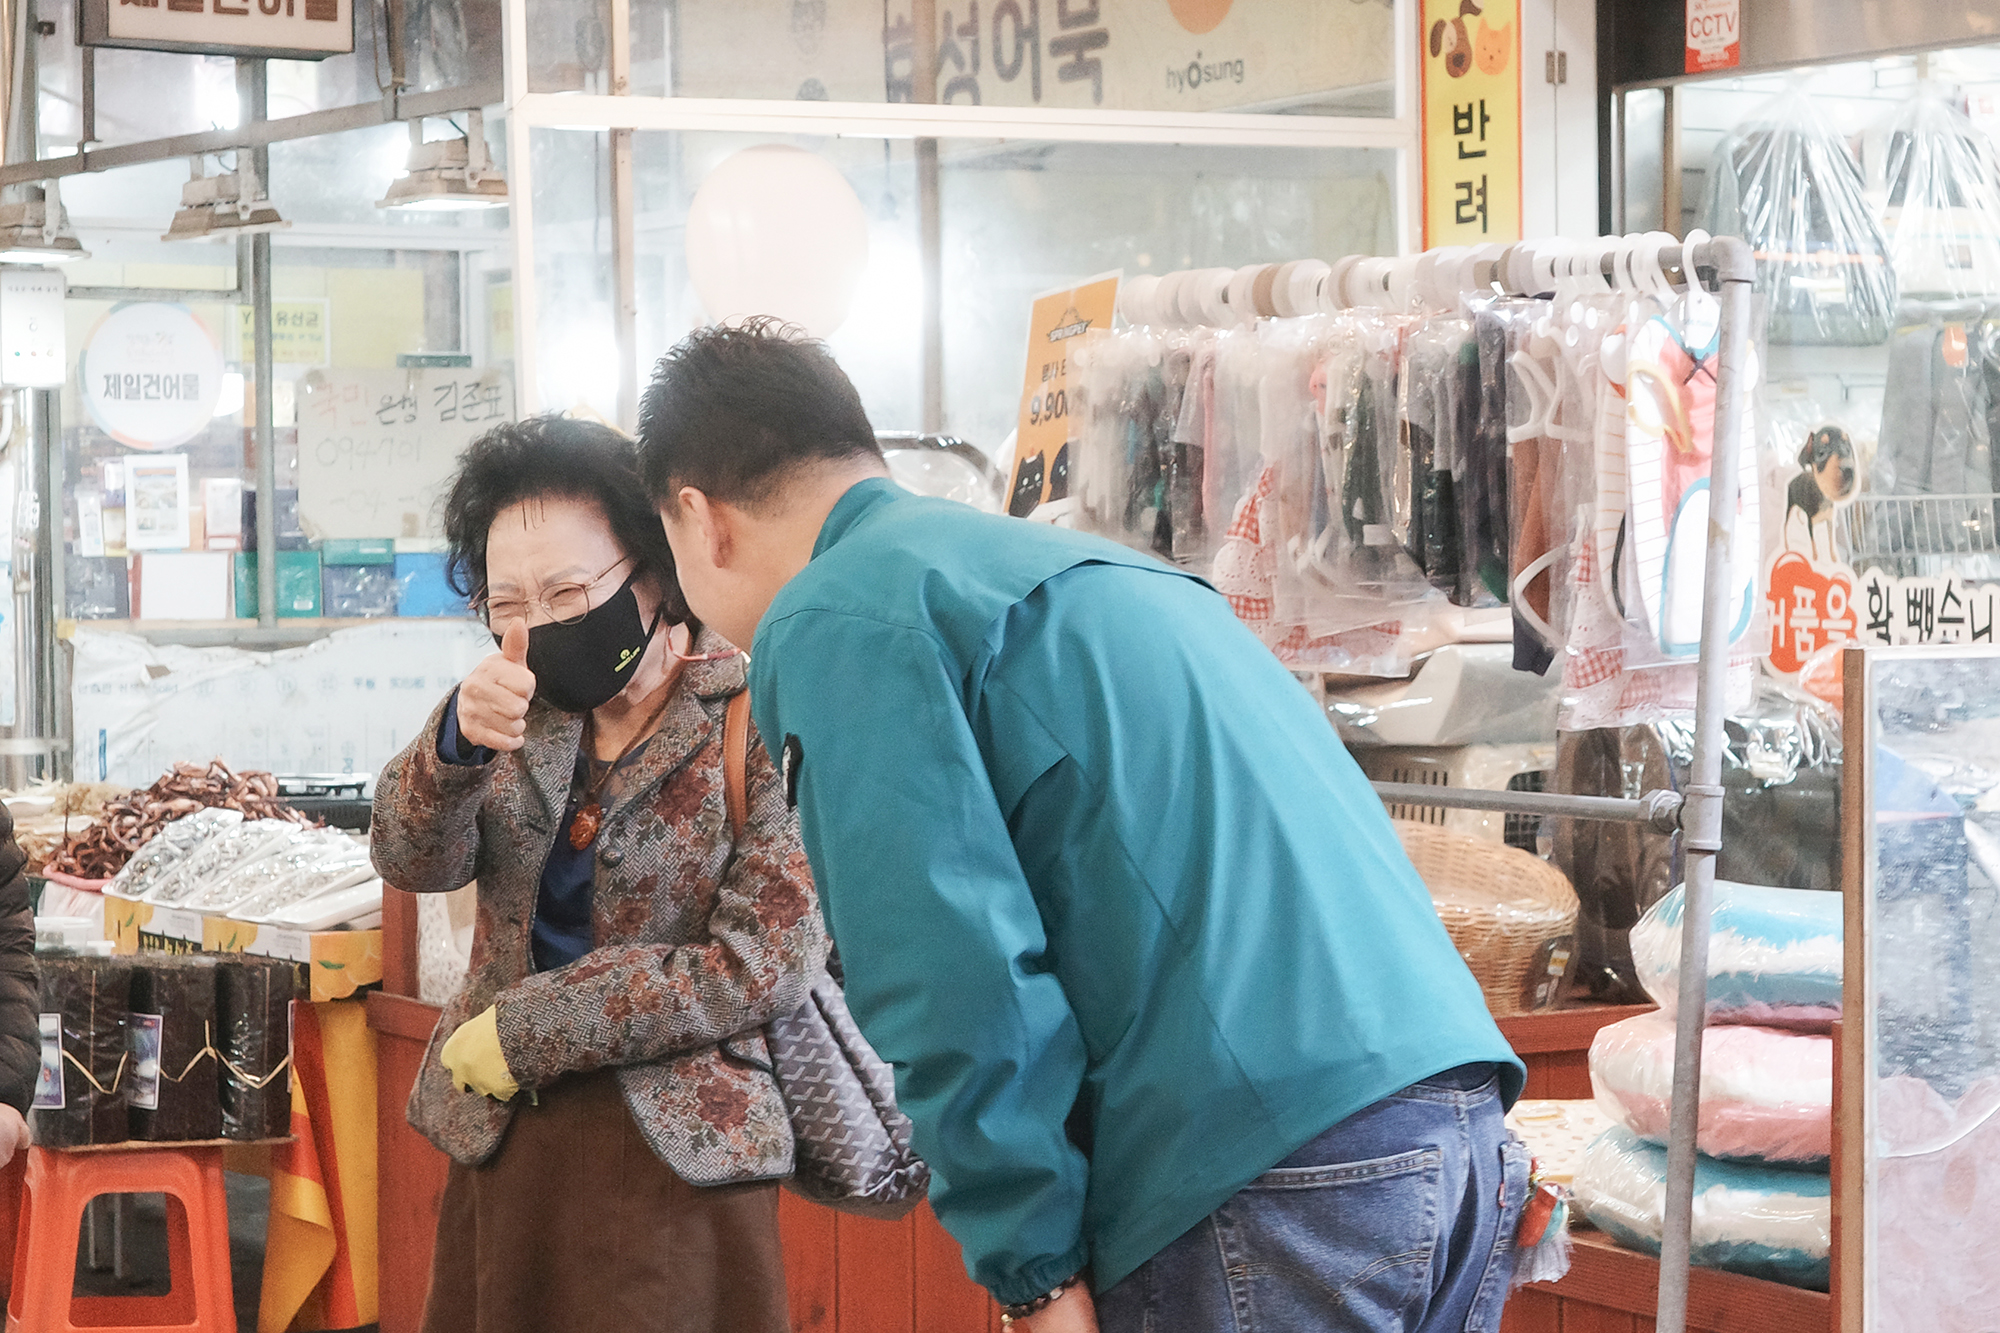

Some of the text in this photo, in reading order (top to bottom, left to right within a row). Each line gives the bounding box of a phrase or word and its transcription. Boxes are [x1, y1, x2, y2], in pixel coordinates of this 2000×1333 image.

[1690, 10, 1737, 38] CCTV
[1453, 98, 1490, 233] 반려
[103, 372, 199, 401] 제일건어물
[312, 382, 370, 428] 국민
